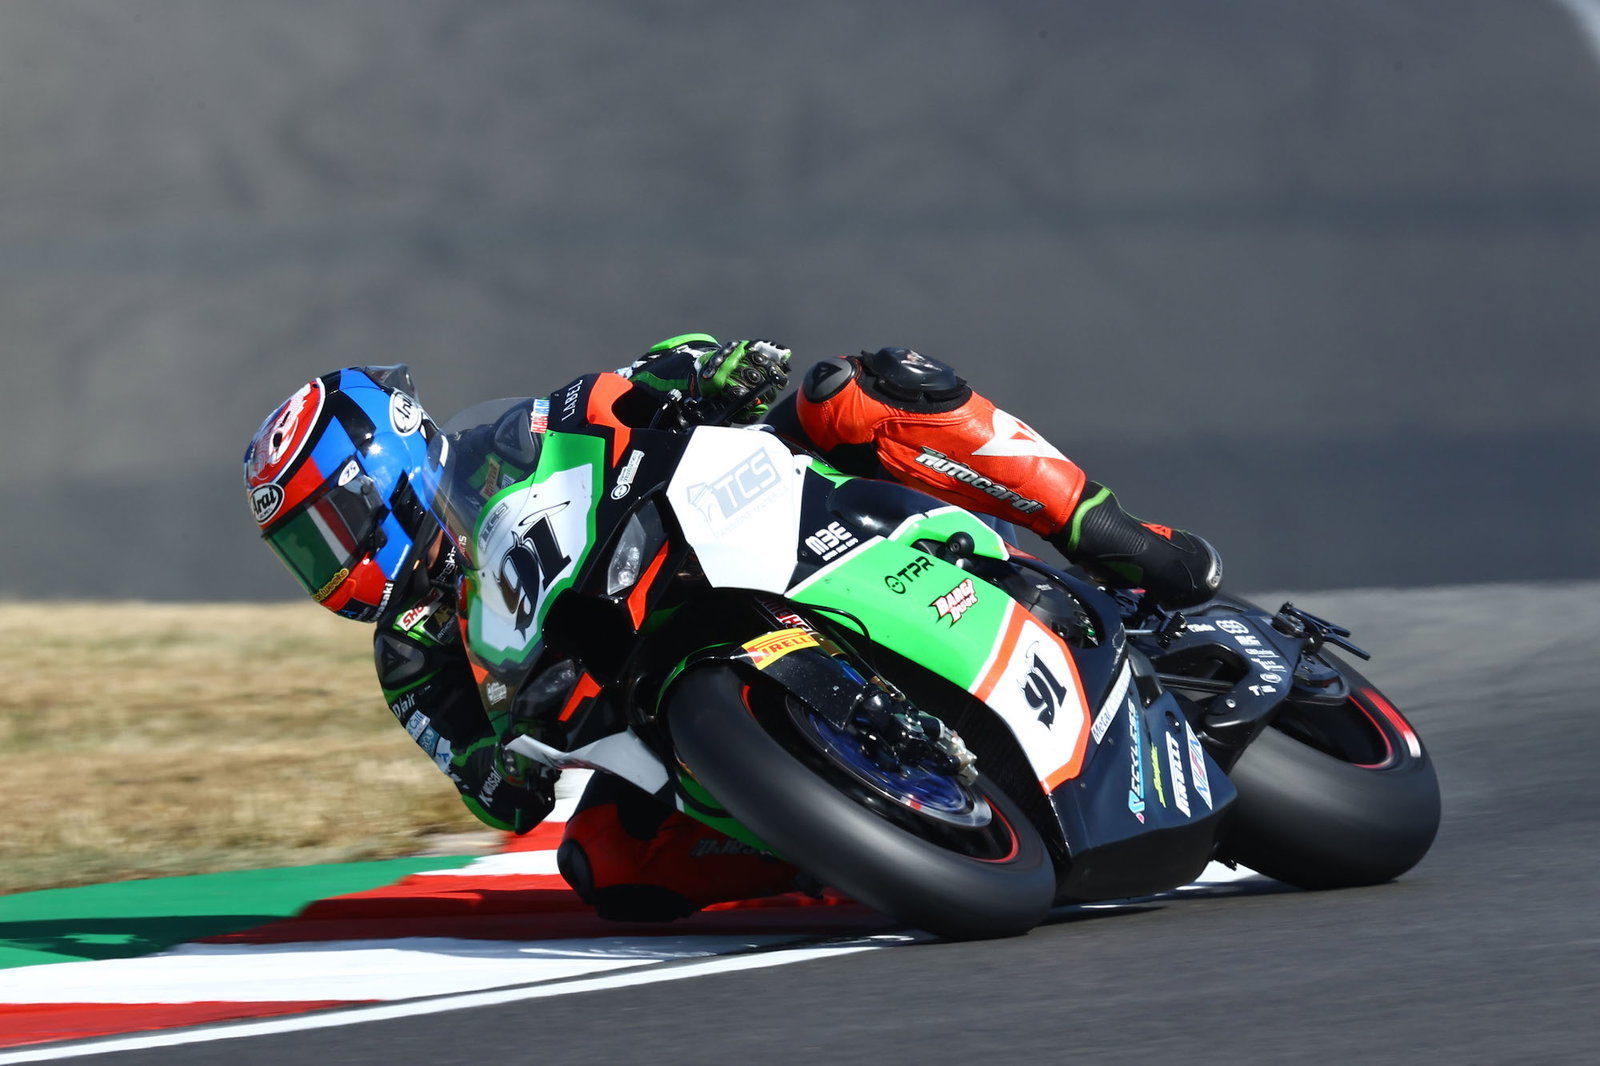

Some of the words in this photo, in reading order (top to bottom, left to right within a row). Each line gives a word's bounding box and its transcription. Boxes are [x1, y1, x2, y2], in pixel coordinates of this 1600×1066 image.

[715, 452, 778, 508] TCS
[493, 500, 572, 642] 91
[898, 556, 934, 583] TPR
[747, 632, 816, 664] PIRELLI
[1017, 641, 1067, 731] 91
[1166, 731, 1191, 818] PIRELLI
